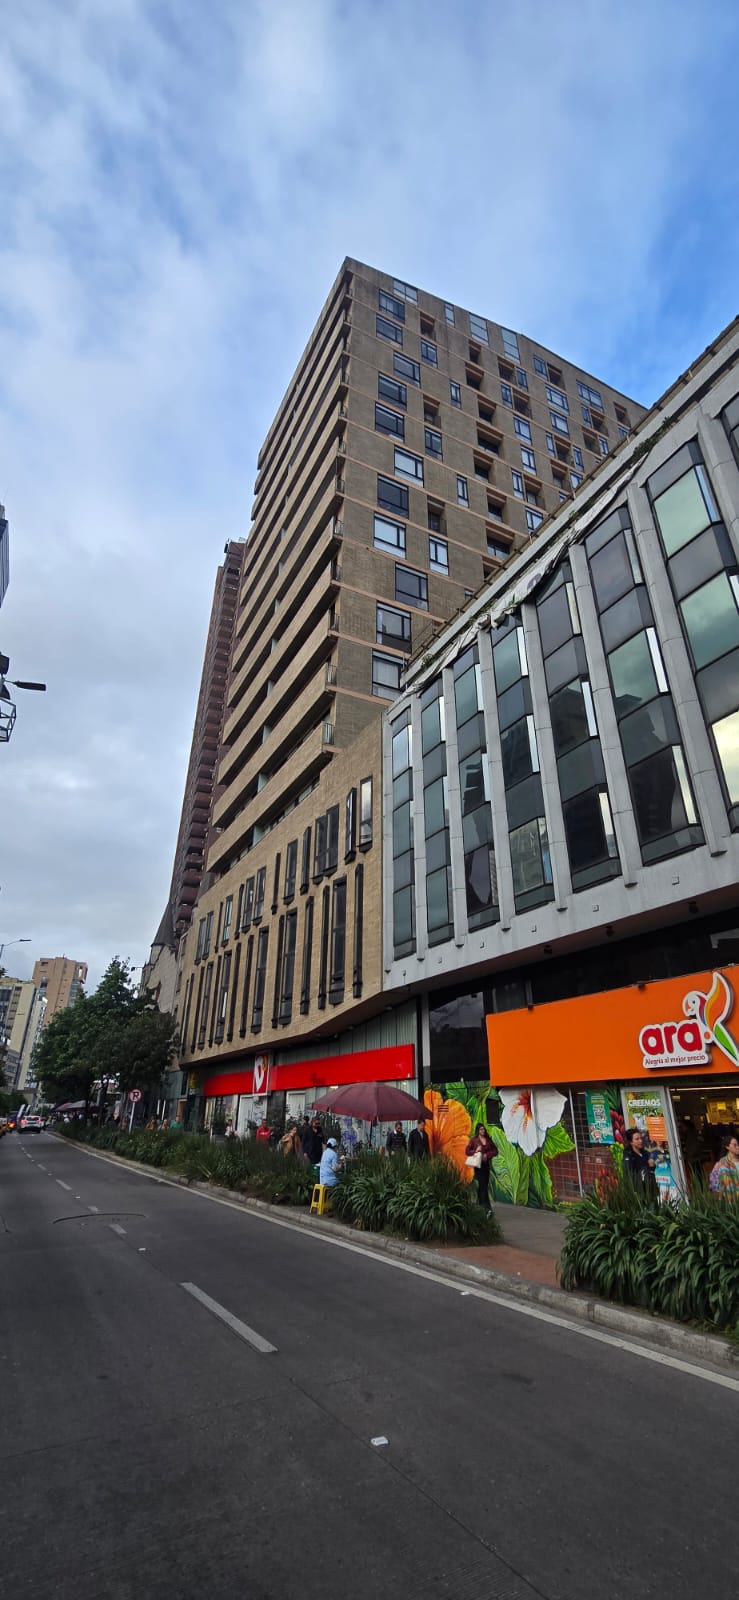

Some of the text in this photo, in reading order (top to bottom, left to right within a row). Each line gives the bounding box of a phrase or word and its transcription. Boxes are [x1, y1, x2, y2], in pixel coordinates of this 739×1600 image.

[642, 1022, 703, 1055] ara
[670, 1056, 686, 1064] mejor
[687, 1055, 705, 1063] precio
[628, 1098, 661, 1107] CREEMOS
